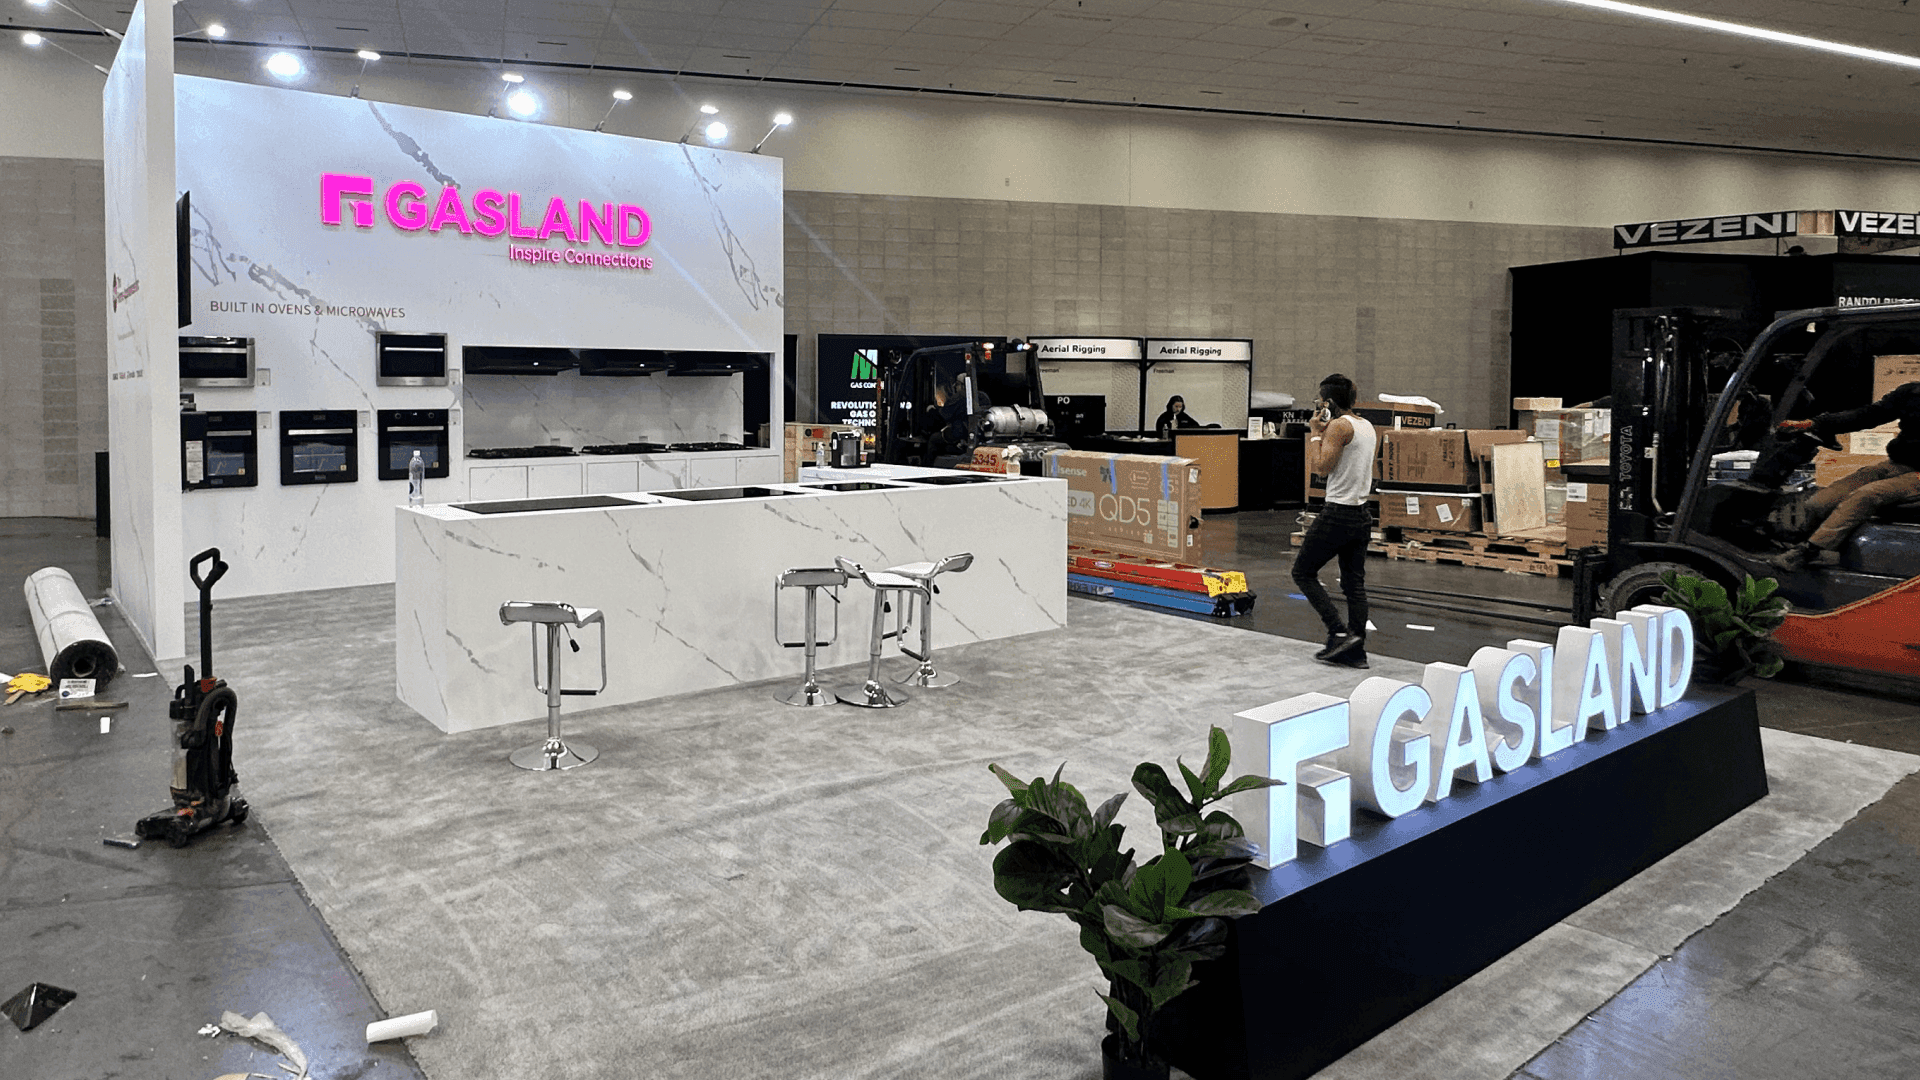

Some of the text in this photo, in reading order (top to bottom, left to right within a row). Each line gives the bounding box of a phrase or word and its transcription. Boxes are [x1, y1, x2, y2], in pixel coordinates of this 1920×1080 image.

[384, 179, 653, 248] GASLAND
[1838, 211, 1920, 235] VEZE
[1615, 212, 1797, 245] VEZENI
[509, 243, 653, 270] Inspire Connections
[210, 300, 406, 318] BUILT IN OVENS & MICROWAVES
[1041, 344, 1106, 354] Aerial Rigging
[1159, 345, 1222, 356] Aerial Rigging
[850, 381, 863, 389] GAS
[849, 409, 868, 418] GAS
[1401, 416, 1431, 427] VEZENI
[1619, 425, 1633, 482] TOYOTA
[1099, 493, 1151, 526] QD5
[1371, 607, 1694, 818] GASLAND
